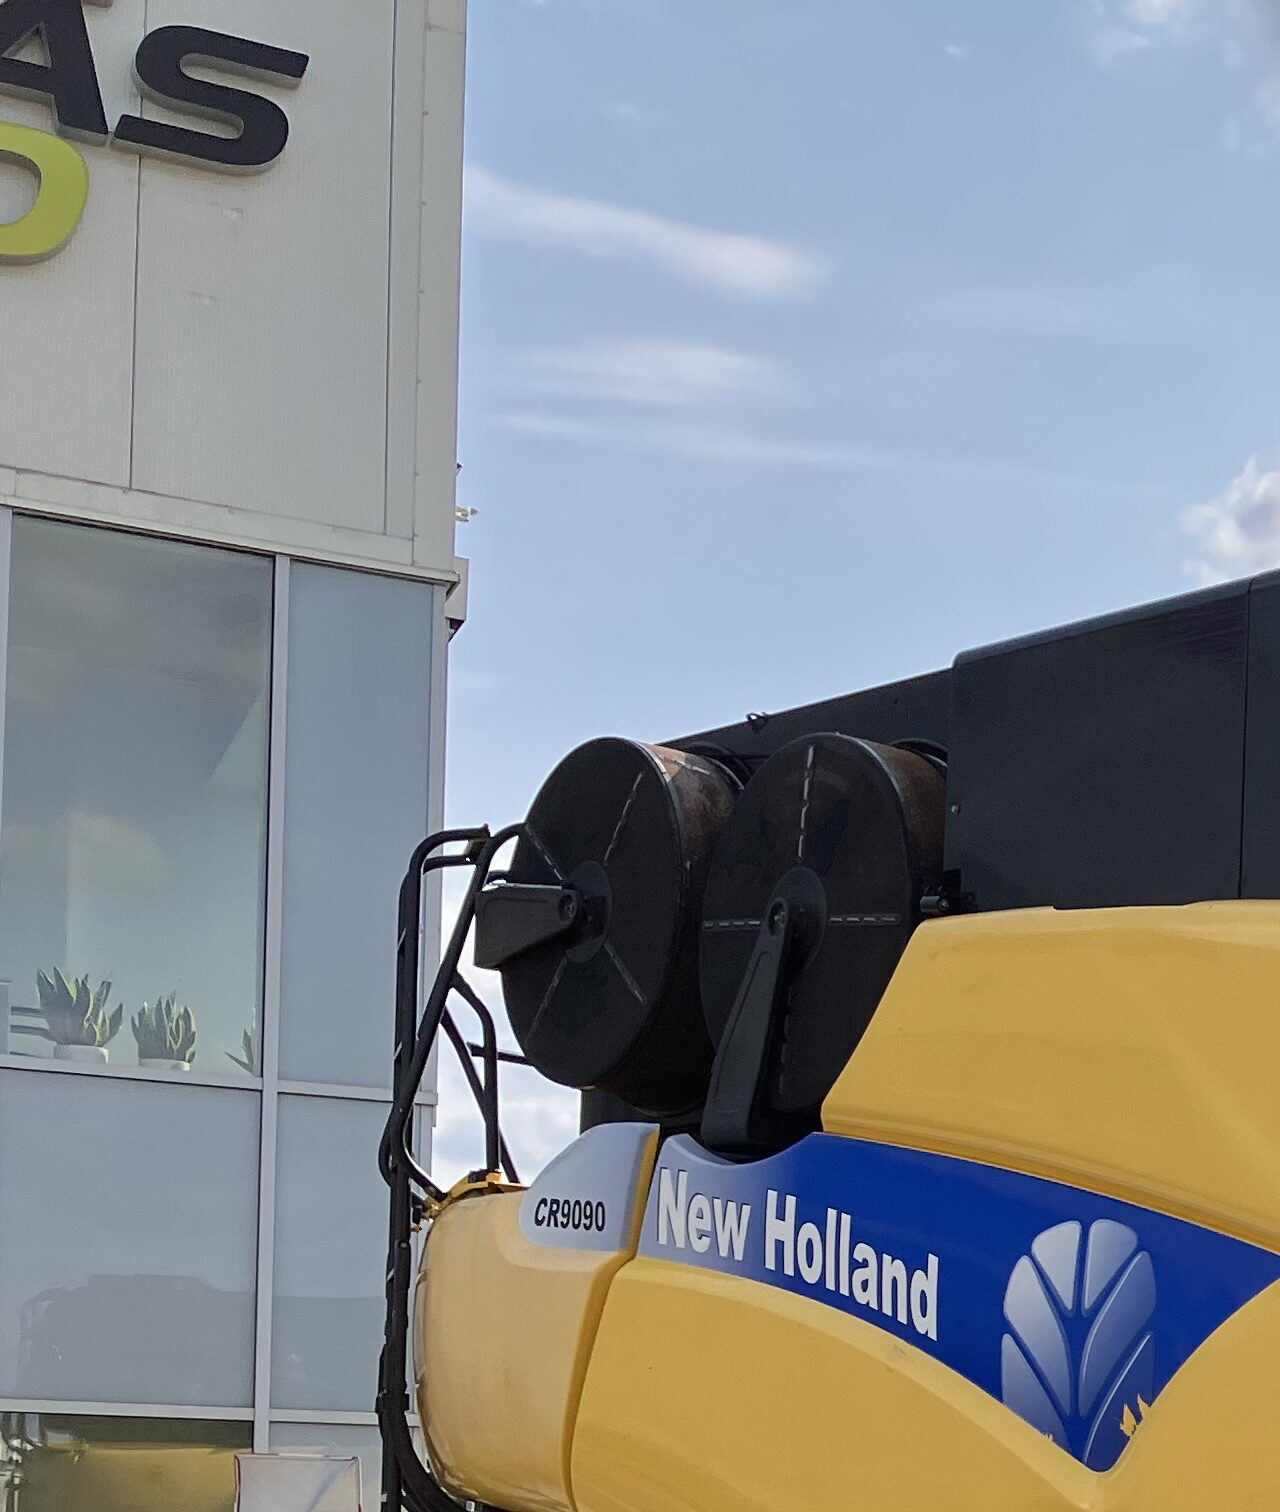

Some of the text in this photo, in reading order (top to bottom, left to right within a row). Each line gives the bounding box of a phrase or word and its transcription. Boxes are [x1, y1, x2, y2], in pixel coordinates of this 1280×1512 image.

[534, 1197, 605, 1232] CR9090
[657, 1167, 938, 1342] New Holland
